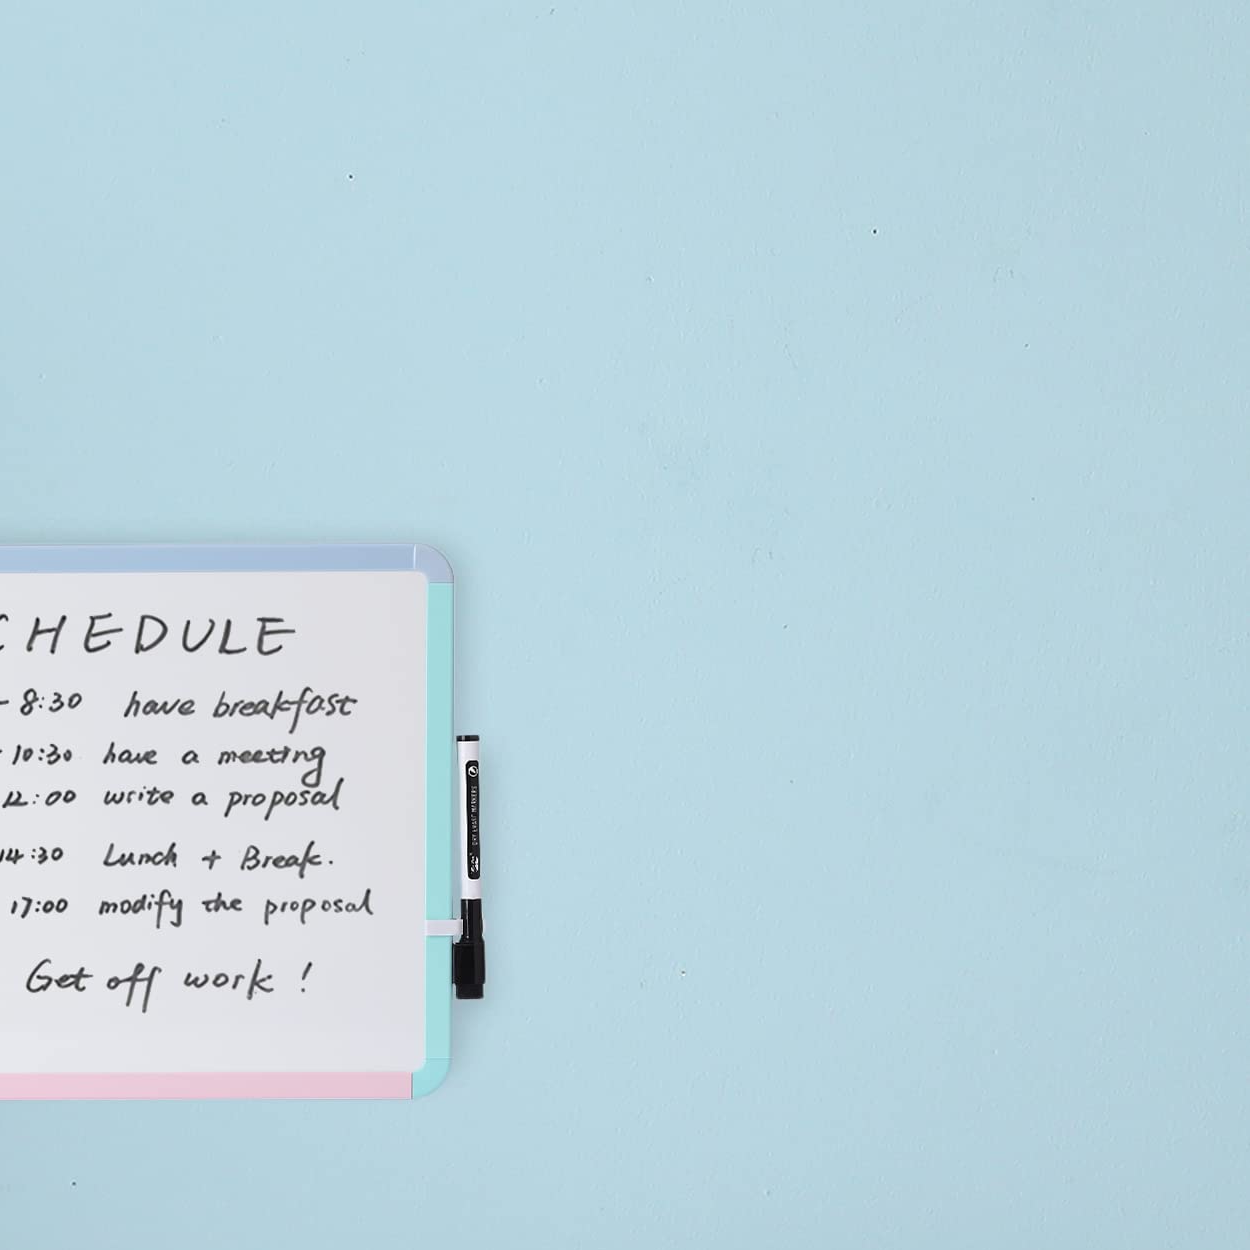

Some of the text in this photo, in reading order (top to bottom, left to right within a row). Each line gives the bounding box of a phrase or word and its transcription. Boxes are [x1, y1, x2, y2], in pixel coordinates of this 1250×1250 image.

[19, 687, 83, 717] 8:30
[123, 690, 196, 718] have
[212, 686, 359, 735] breakfast
[11, 743, 73, 766] 10:30
[102, 741, 158, 766] have
[180, 749, 200, 766] a
[217, 745, 327, 788] meeting
[103, 785, 175, 807] write
[190, 791, 209, 807] a
[223, 776, 345, 822] proposal
[102, 841, 178, 868] Lunch
[201, 849, 222, 871] +
[239, 839, 334, 880] Break.
[10, 896, 69, 920] 17:00
[98, 888, 184, 930] modify
[201, 891, 243, 913] the
[263, 887, 374, 926] proposal
[25, 958, 94, 994] Get
[106, 962, 163, 1014] off
[183, 958, 275, 1001] work
